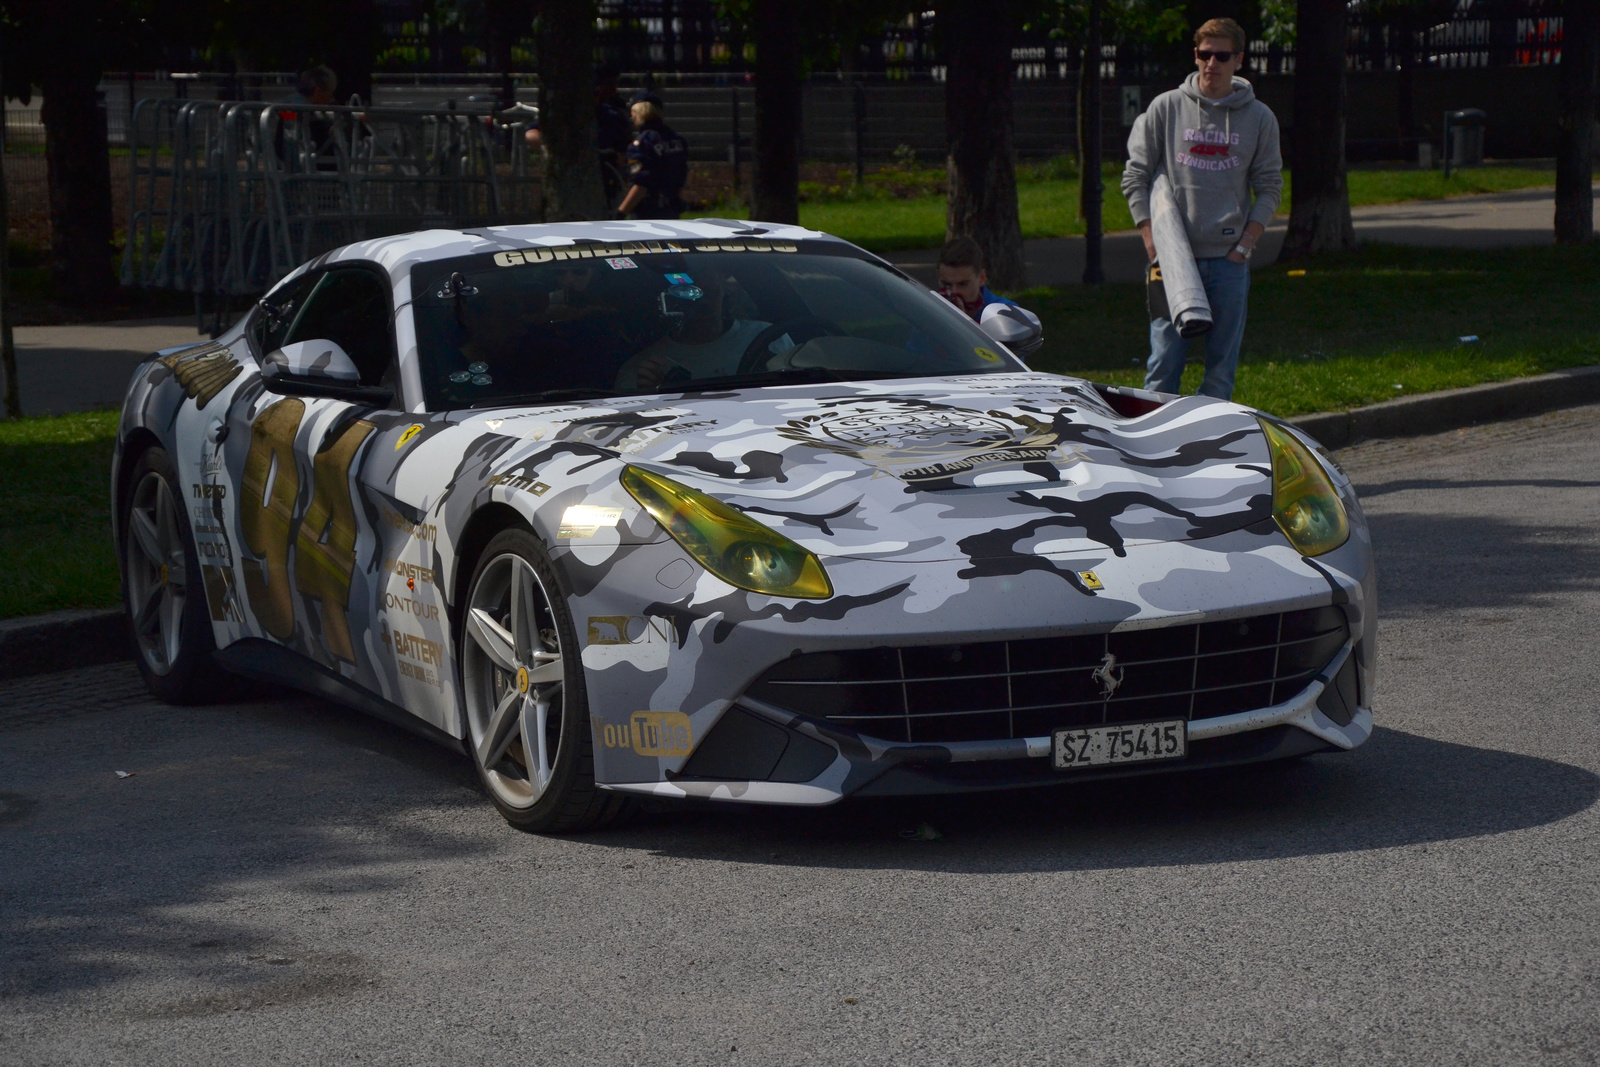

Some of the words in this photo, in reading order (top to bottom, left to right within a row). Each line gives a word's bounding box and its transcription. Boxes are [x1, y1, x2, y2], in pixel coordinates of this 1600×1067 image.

[1183, 128, 1240, 145] RACING
[1176, 152, 1240, 171] SYNDICATE
[493, 239, 690, 268] GUMBALL
[943, 449, 1054, 471] ANNIVERSARY
[378, 590, 440, 622] CONTOUR
[623, 615, 678, 644] CNI
[394, 629, 444, 669] BATTERY
[591, 714, 692, 752] YouTube
[1062, 733, 1091, 763] SZ
[1106, 724, 1178, 760] 75415
